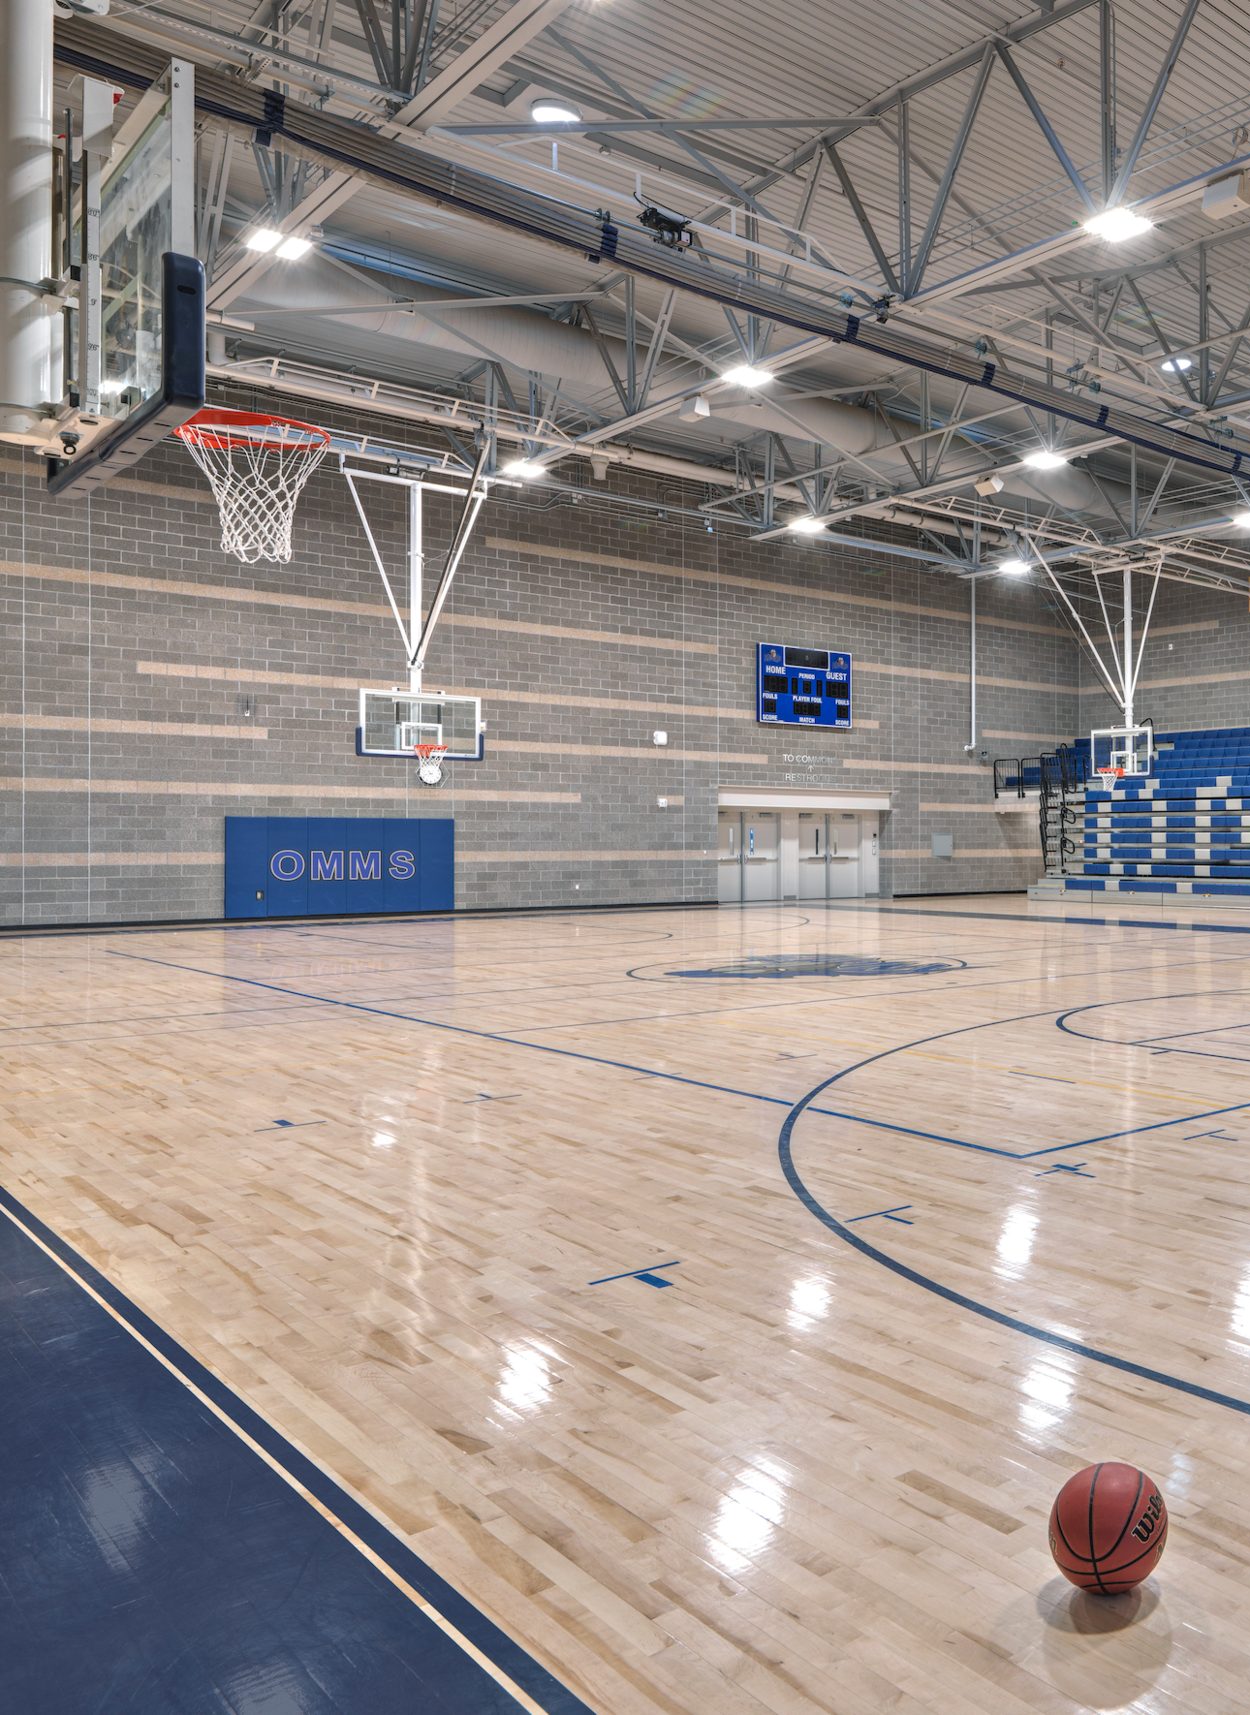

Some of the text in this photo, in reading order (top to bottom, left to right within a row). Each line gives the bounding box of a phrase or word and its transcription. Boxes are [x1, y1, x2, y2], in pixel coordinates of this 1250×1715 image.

[765, 665, 786, 675] HOME
[798, 672, 816, 680] PERIOD
[826, 671, 848, 681] GUEST
[762, 692, 778, 700] FOULS
[792, 695, 823, 704] PLAYER FOUL
[798, 716, 816, 724] MATCH
[782, 753, 837, 764] TO COMMONS
[785, 773, 836, 783] RESTROOMS
[270, 849, 416, 881] OMMS
[1131, 1486, 1164, 1544] Wils
